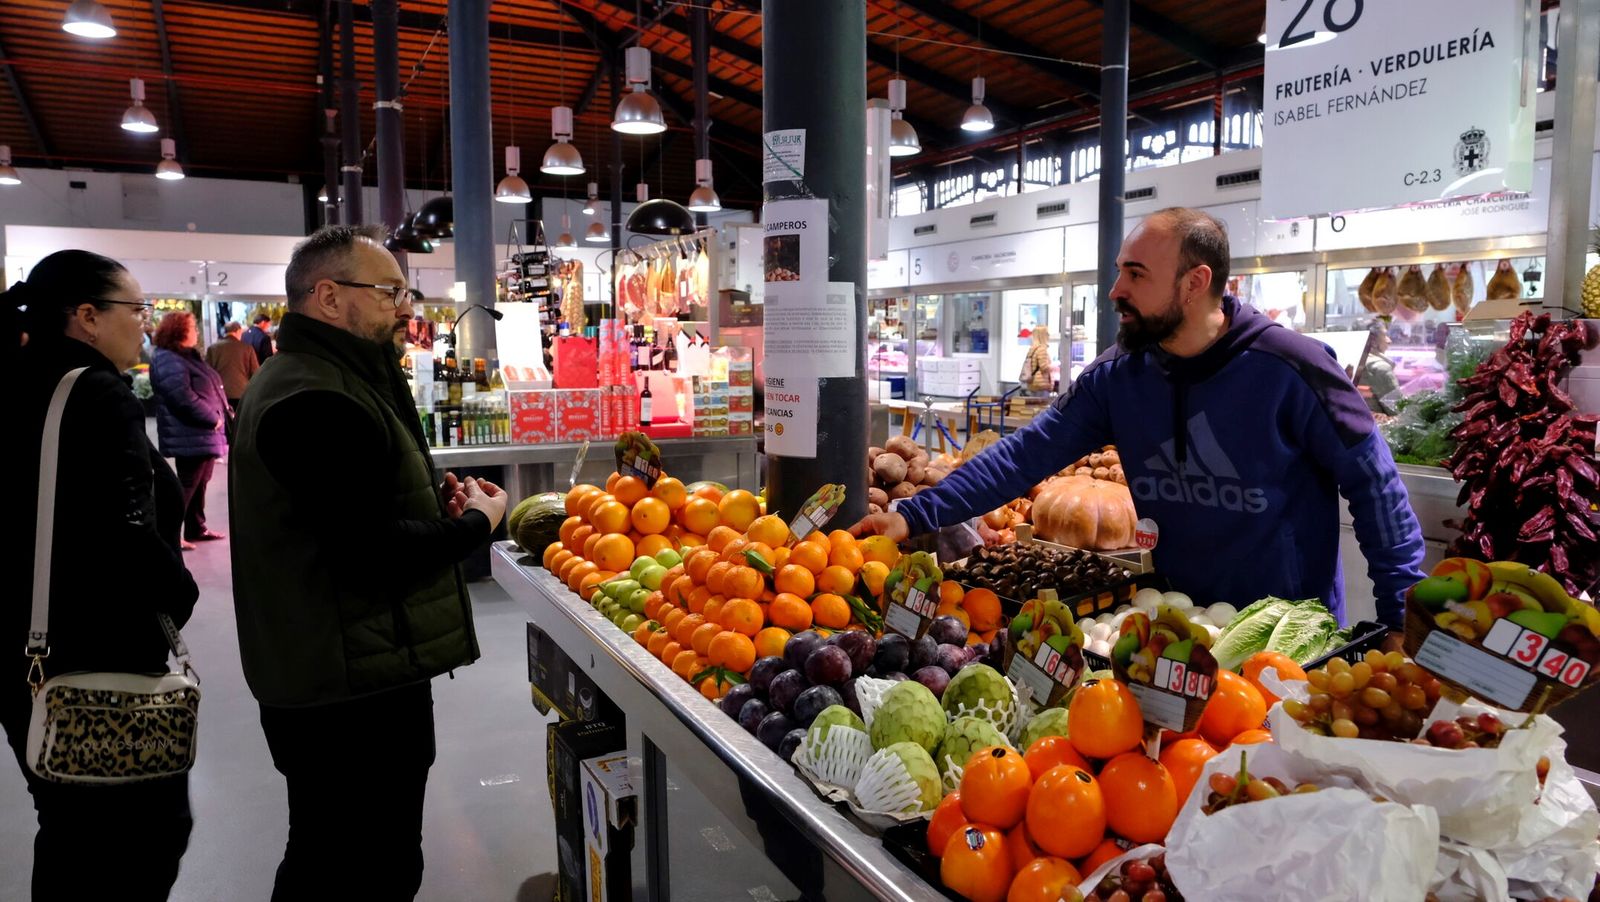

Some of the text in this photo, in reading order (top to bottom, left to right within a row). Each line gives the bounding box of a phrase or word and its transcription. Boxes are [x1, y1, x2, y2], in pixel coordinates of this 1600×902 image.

[1275, 28, 1495, 100] FRUTERÍA VERDULERÍA
[1274, 78, 1427, 126] ISABEL FERNÁNDEZ
[1404, 168, 1441, 186] C-2.3
[766, 220, 807, 232] CAMPEROS
[914, 258, 921, 275] 5
[217, 272, 228, 286] 2
[775, 393, 800, 403] TOCAR
[1131, 466, 1268, 513] adidas
